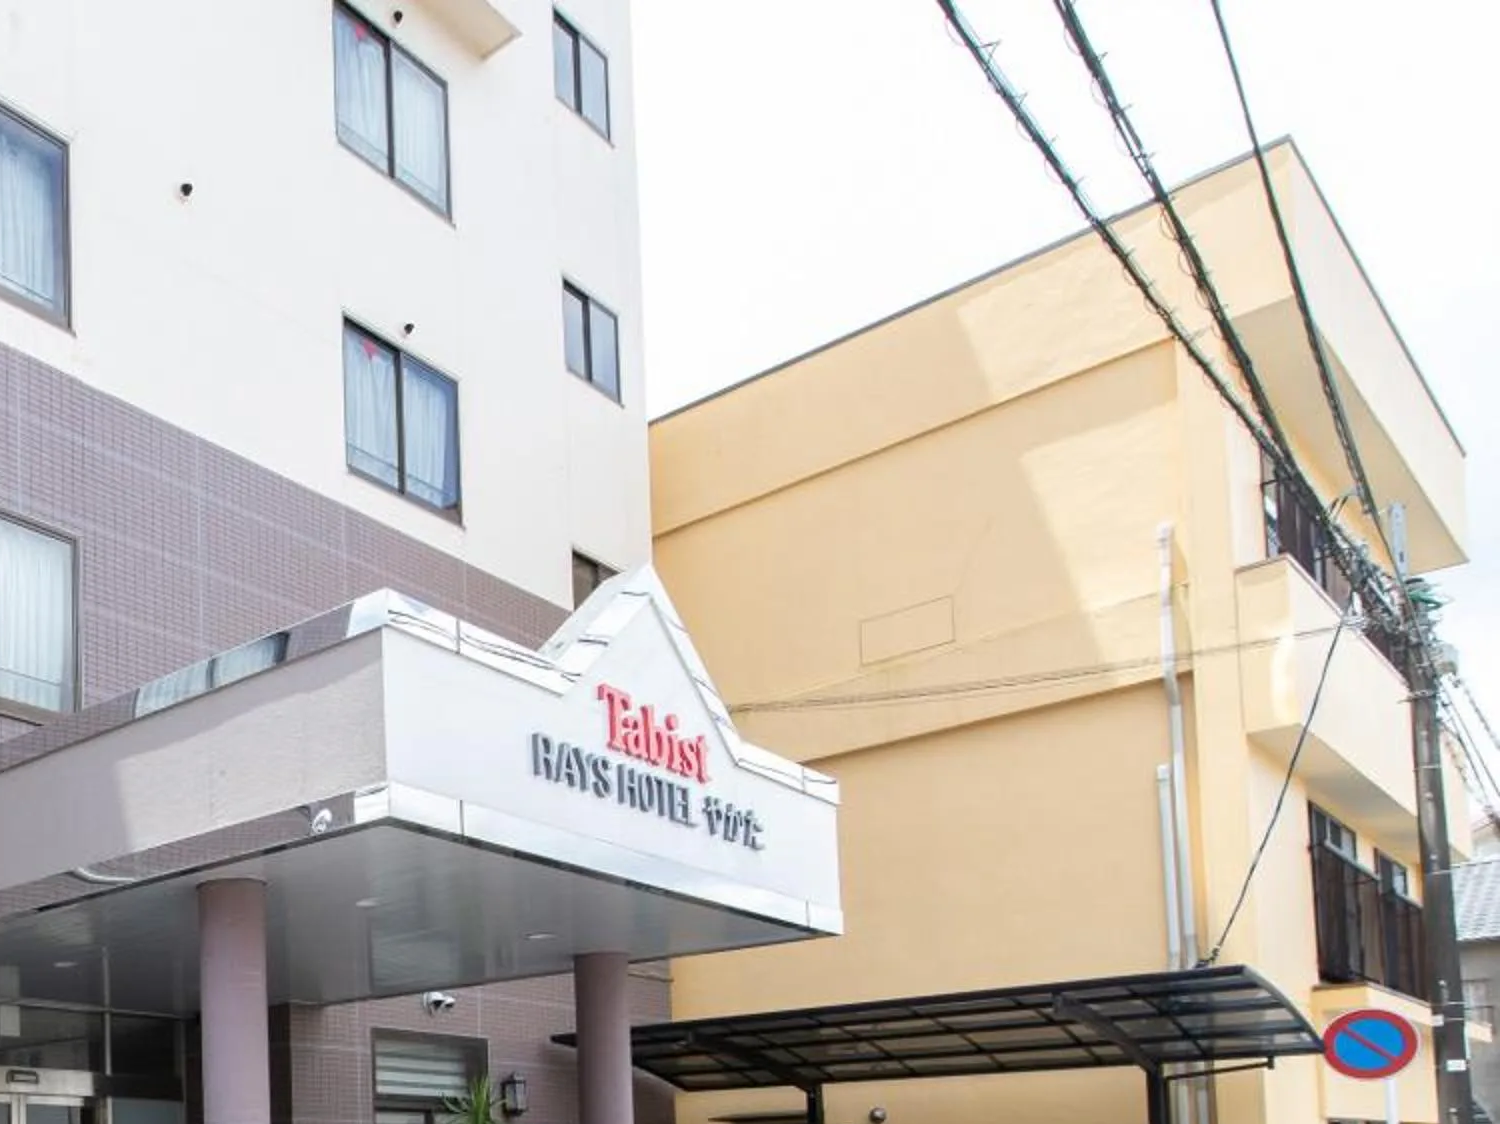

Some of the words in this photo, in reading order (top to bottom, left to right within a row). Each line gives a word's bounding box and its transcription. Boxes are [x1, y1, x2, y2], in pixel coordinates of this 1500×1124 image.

[596, 682, 712, 785] Tabist
[532, 732, 612, 799] RAYS
[616, 763, 699, 828] HOTEL
[702, 795, 765, 851] やかた
